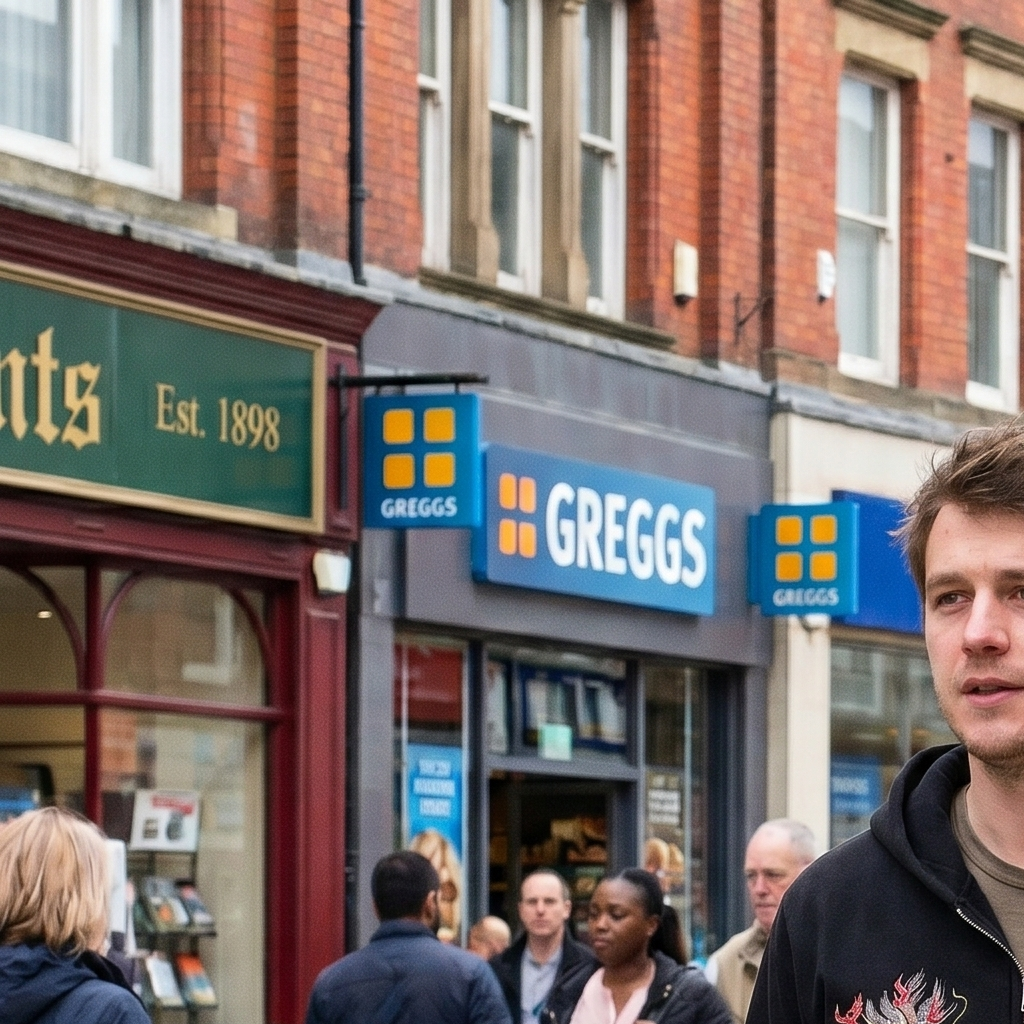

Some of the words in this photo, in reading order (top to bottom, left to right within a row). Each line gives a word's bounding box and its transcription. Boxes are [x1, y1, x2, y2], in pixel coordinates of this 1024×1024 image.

[155, 382, 206, 439] Est.
[218, 396, 281, 453] 1898
[380, 496, 458, 519] GREGGS
[545, 482, 707, 589] GREGGS
[772, 587, 840, 607] GREGGS
